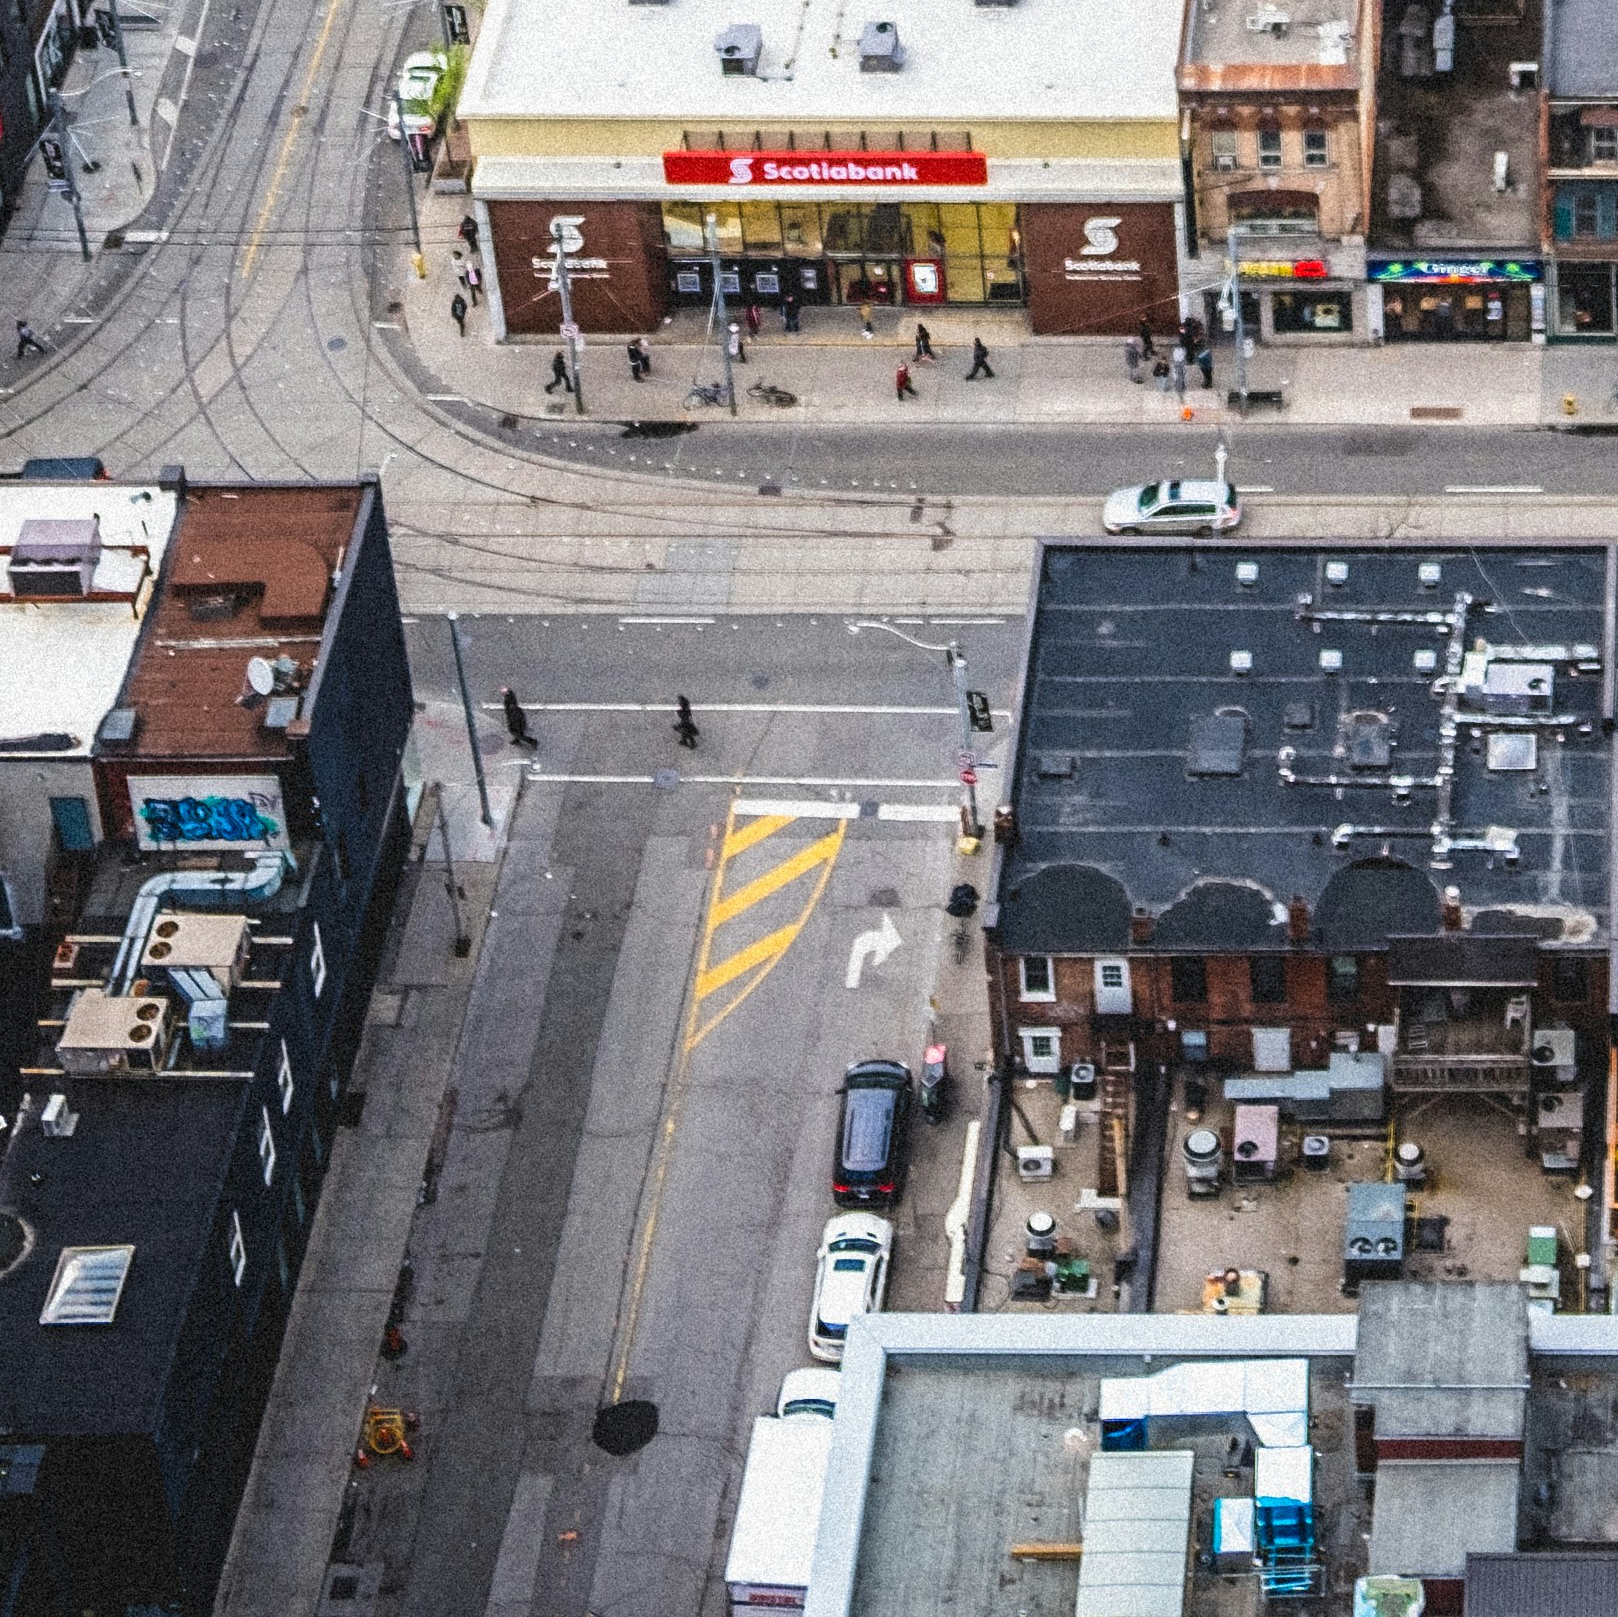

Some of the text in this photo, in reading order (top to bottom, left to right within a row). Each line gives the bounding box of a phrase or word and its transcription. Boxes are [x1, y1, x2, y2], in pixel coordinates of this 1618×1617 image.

[763, 162, 918, 181] Scotiabank
[531, 256, 608, 269] Scoabank
[1064, 257, 1141, 272] Scotiabank
